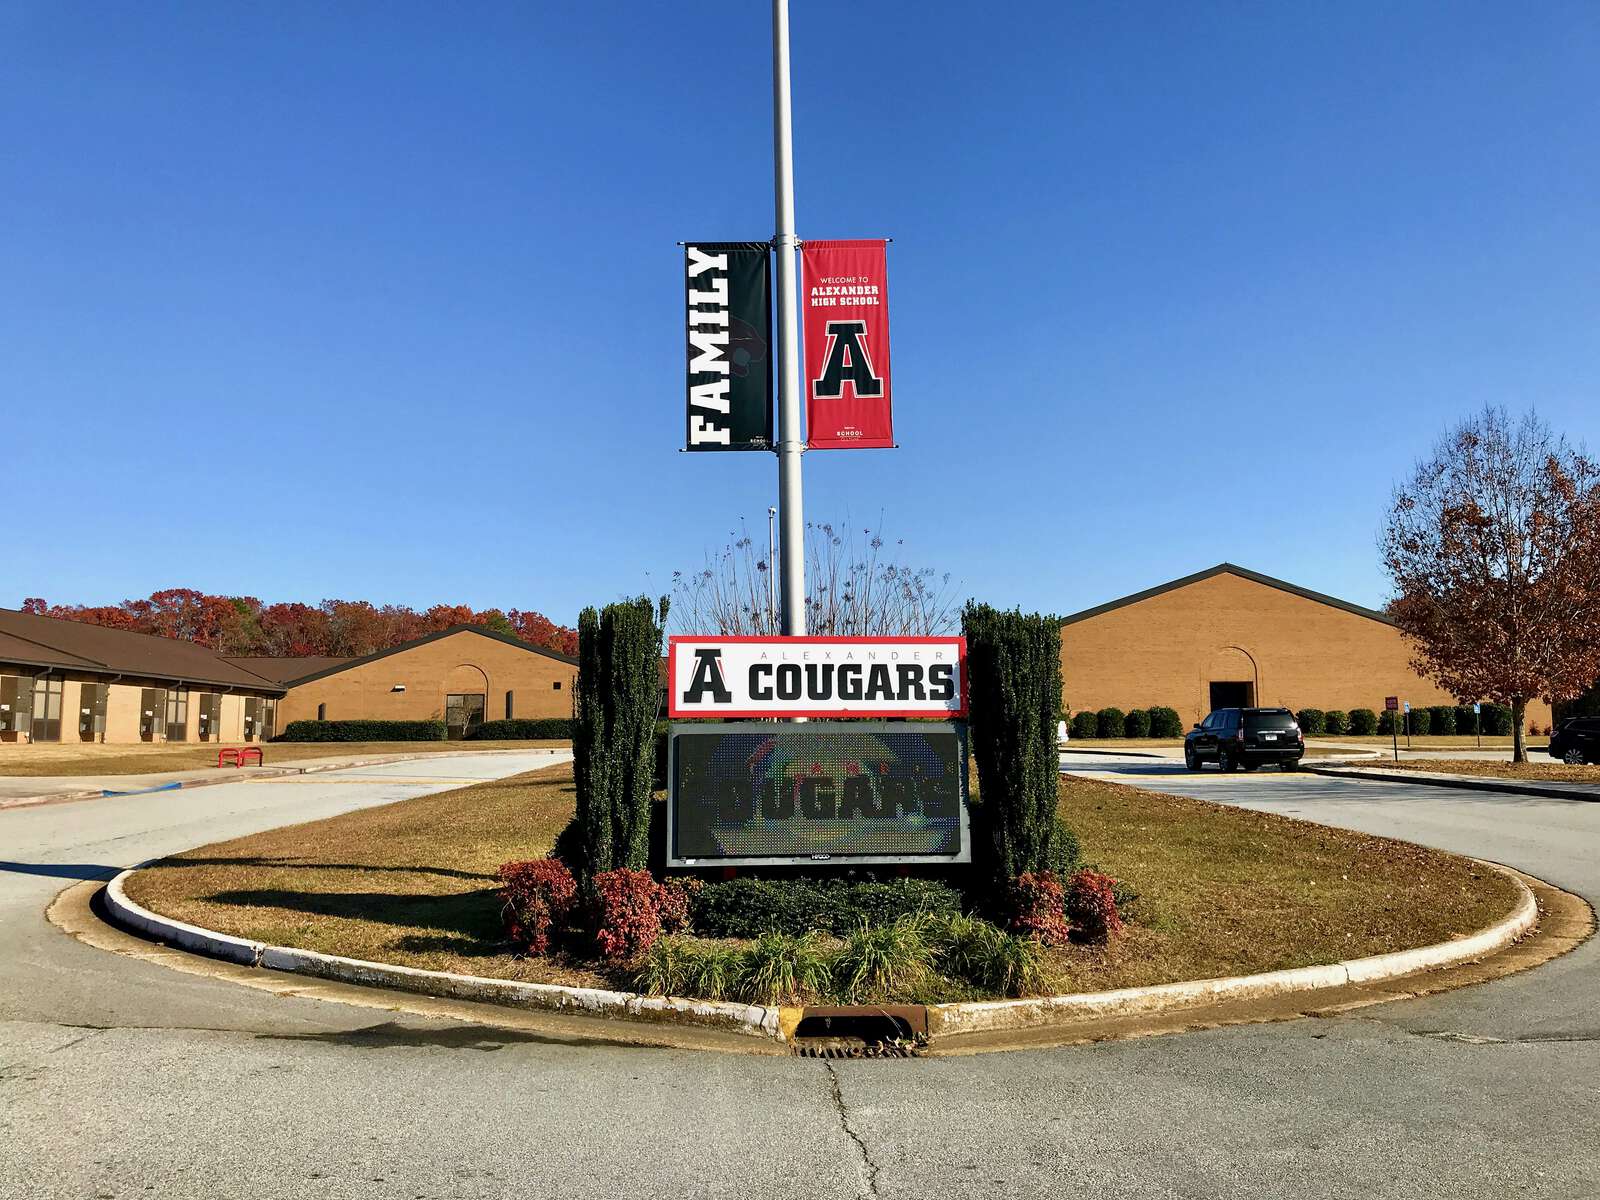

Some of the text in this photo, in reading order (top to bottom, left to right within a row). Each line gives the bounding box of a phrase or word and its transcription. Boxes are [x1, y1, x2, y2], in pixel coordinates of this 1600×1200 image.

[811, 285, 879, 296] ALEXANDER
[820, 276, 869, 284] WELCOME TO
[811, 296, 880, 307] HIGH SCHOOL
[687, 247, 731, 445] FAMILY
[812, 319, 884, 400] A
[760, 651, 943, 661] ALEXANDER
[683, 648, 732, 703] A
[748, 663, 955, 701] COUGARS
